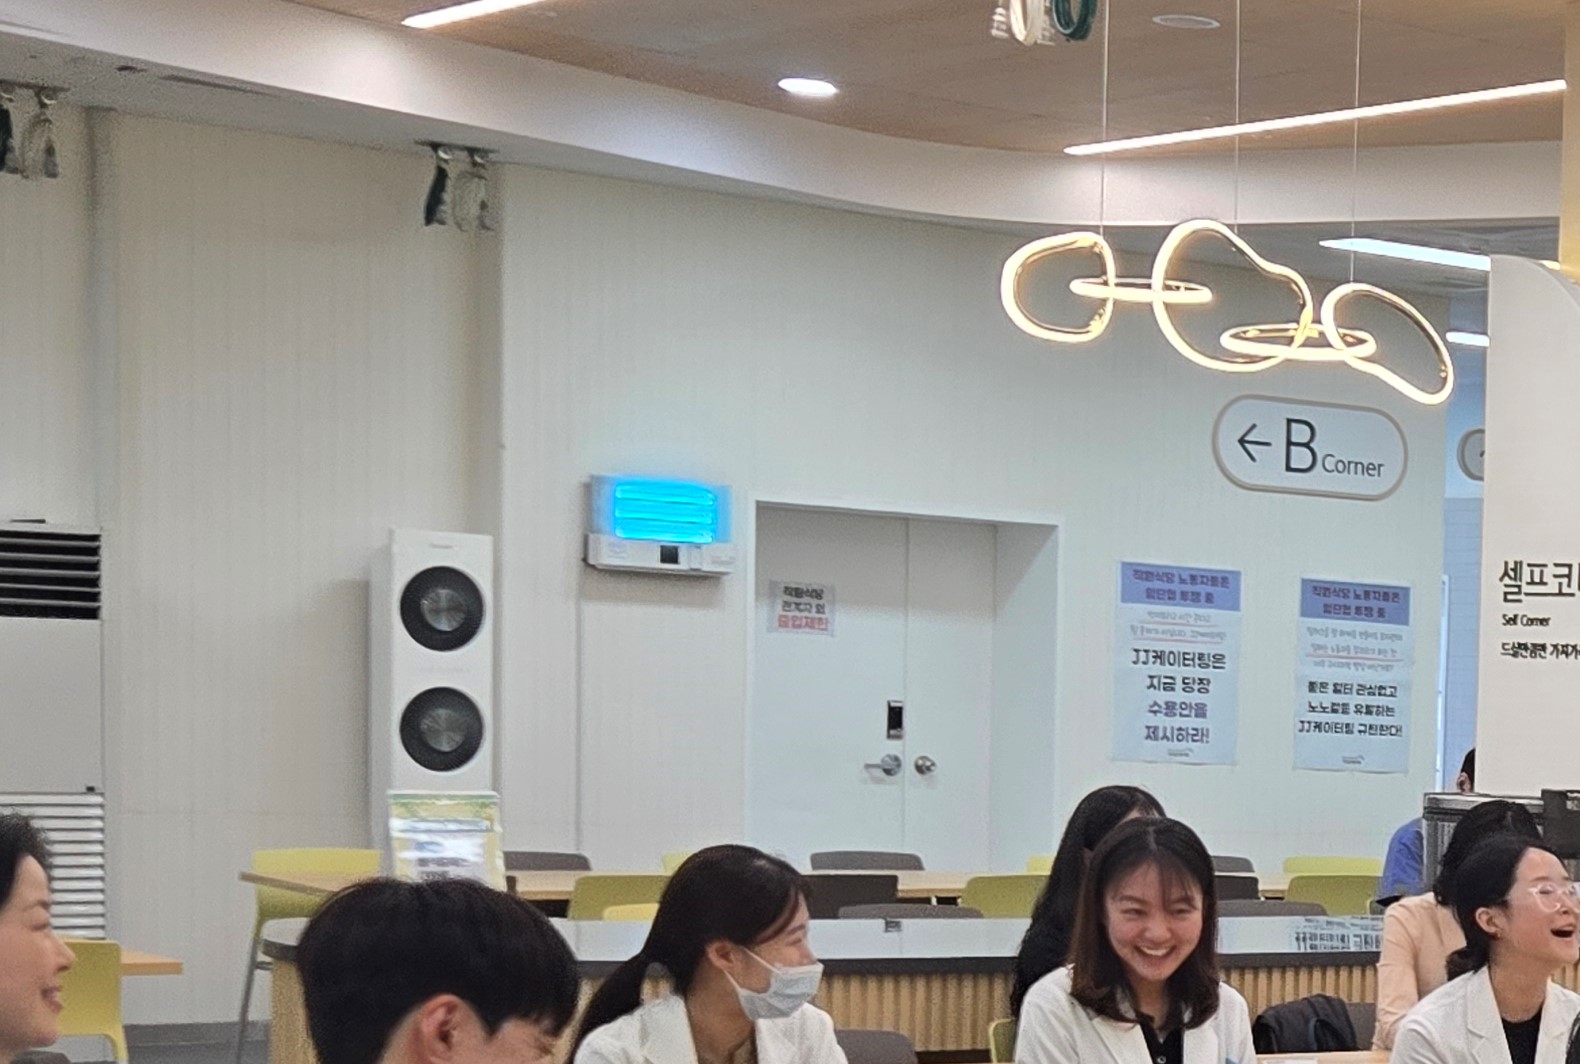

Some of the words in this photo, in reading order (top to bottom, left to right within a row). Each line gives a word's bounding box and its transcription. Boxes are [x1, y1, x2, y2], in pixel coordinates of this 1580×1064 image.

[1285, 418, 1318, 474] B
[1321, 453, 1384, 478] Corner
[1502, 614, 1518, 627] Self
[1520, 614, 1551, 627] Corner
[1131, 648, 1226, 670] JJ케이터링은
[1147, 674, 1177, 692] 지금
[1181, 676, 1212, 694] 당장
[1148, 700, 1208, 719] 수용안을
[1144, 725, 1210, 744] 제시하라!
[1298, 720, 1355, 735] JJ케이터링
